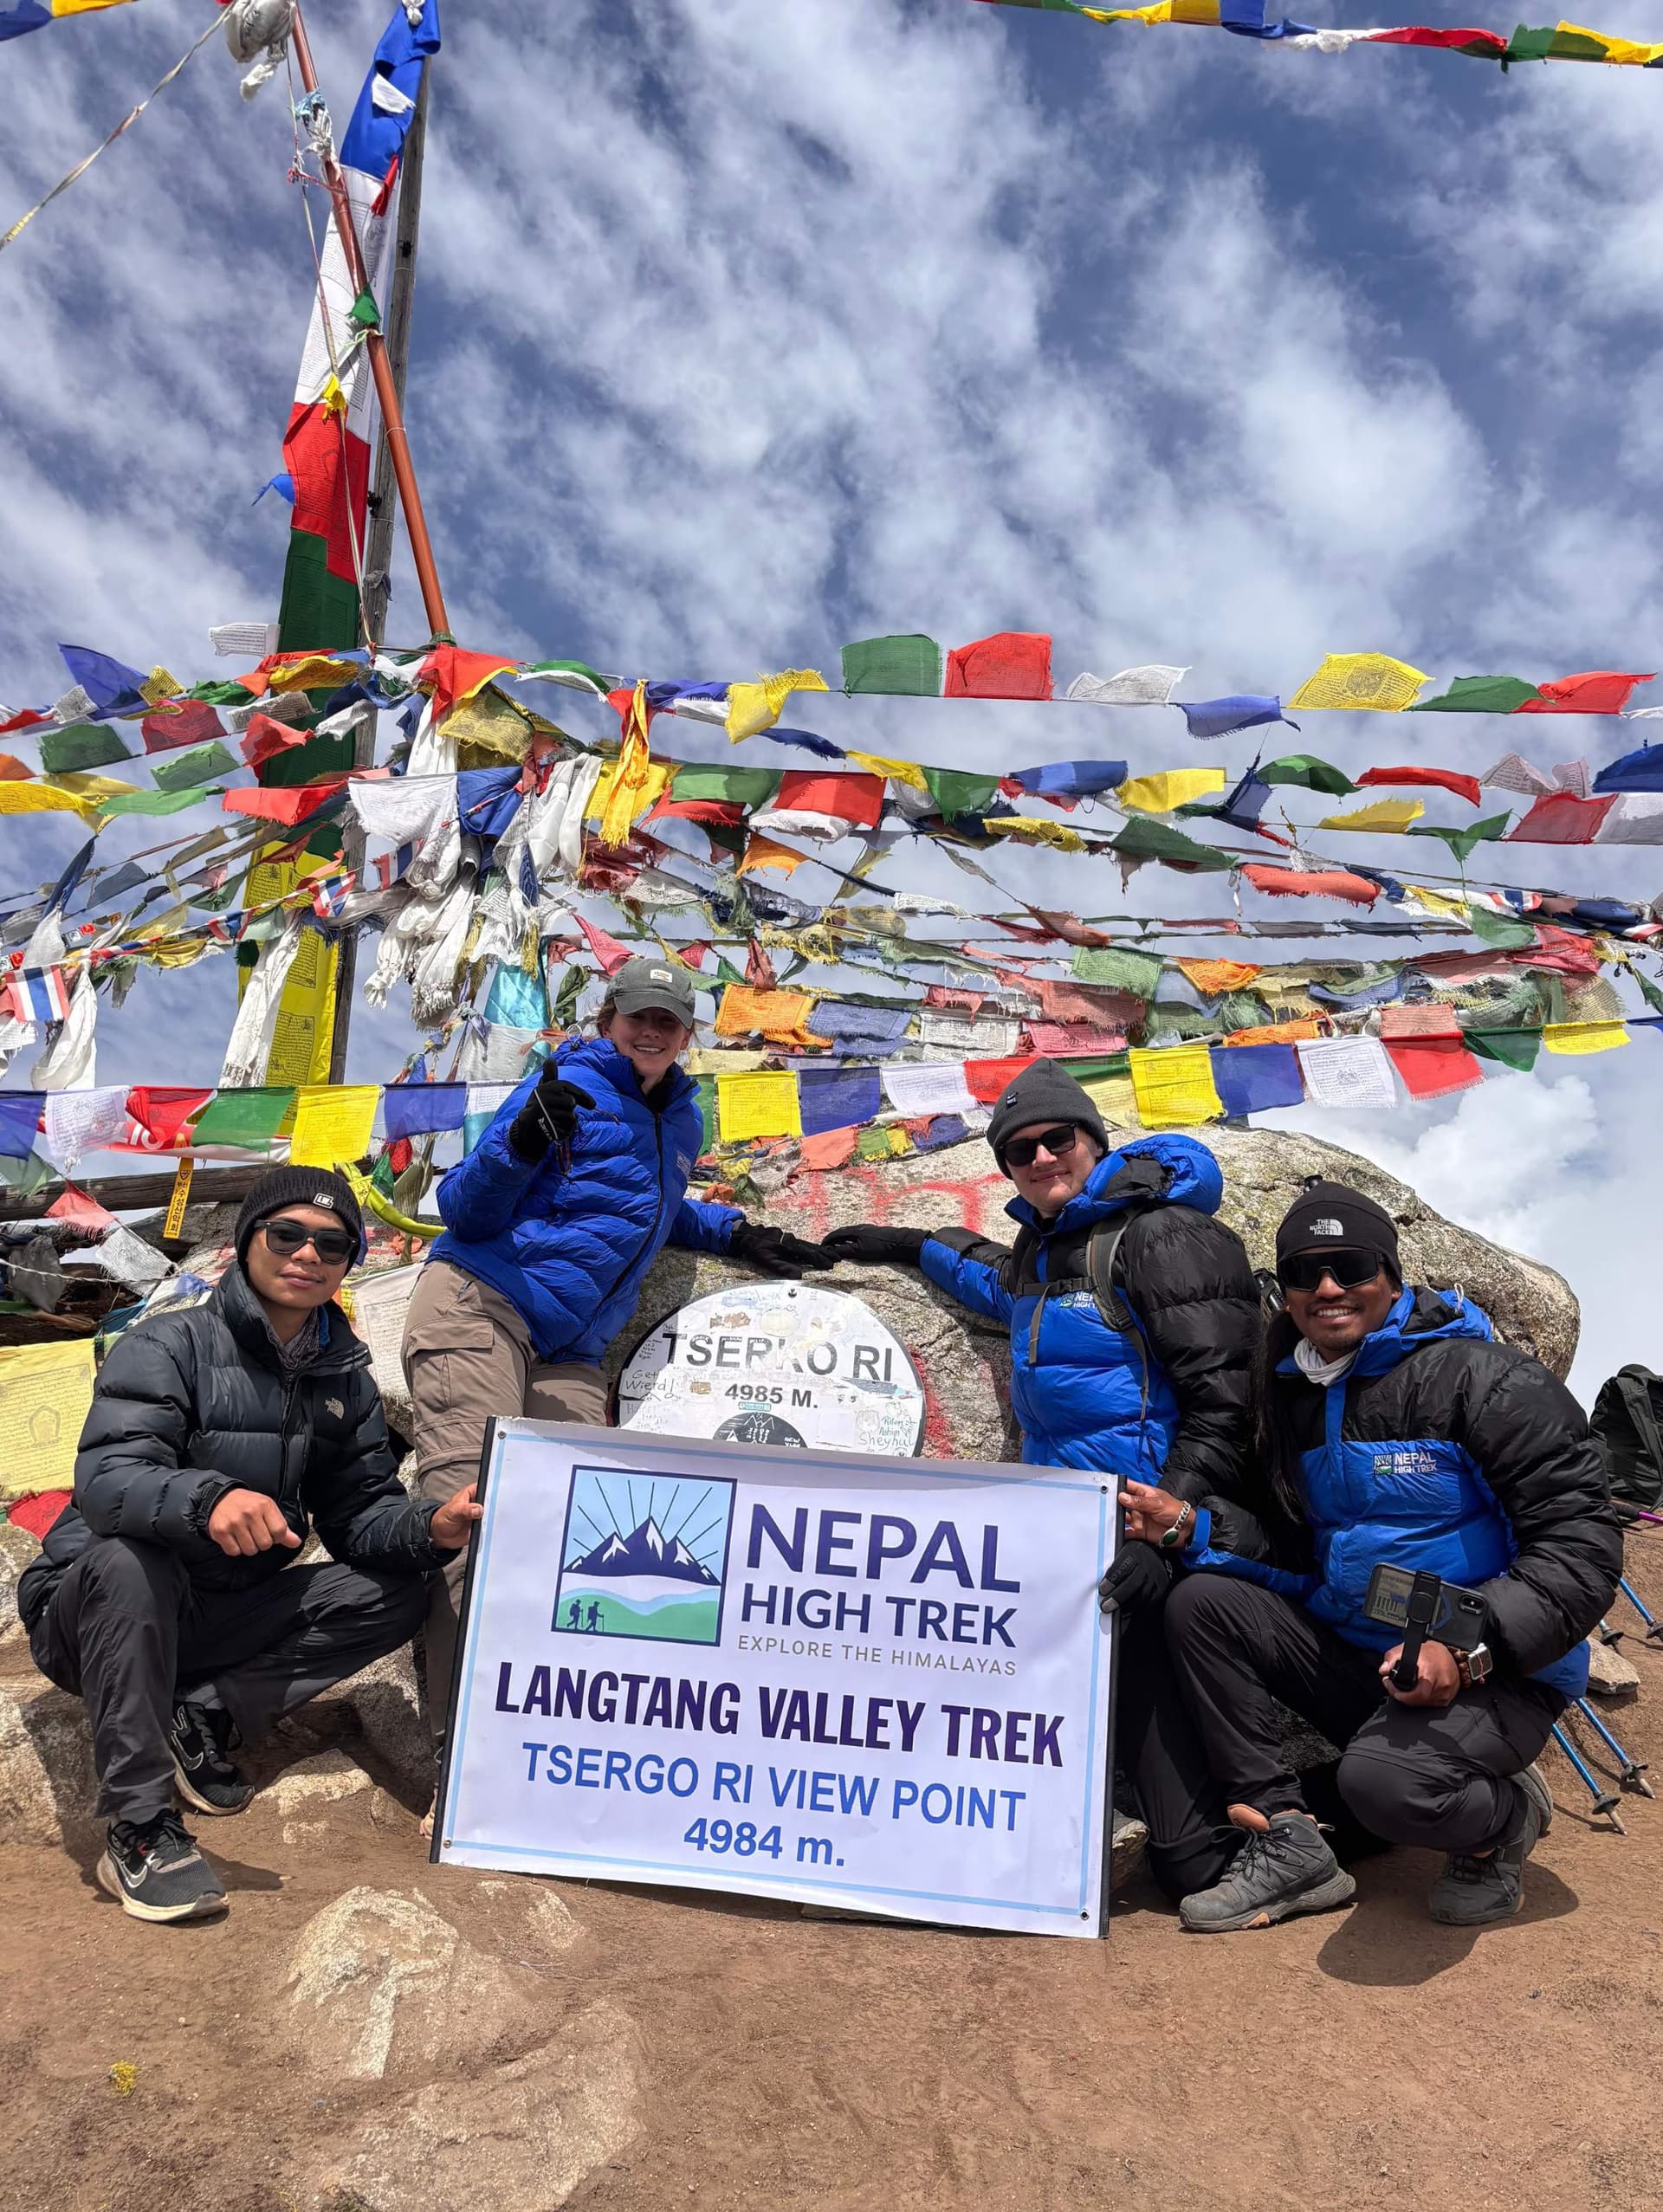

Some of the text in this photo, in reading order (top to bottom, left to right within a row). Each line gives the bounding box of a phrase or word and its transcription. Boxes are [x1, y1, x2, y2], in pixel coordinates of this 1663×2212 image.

[632, 1369, 659, 1379] Get
[852, 1344, 893, 1382] RI
[724, 1383, 819, 1409] 4985 M.
[1394, 1452, 1437, 1465] NEPAL
[1394, 1463, 1438, 1474] HIGH TREK
[746, 1503, 1021, 1594] NEPAL
[741, 1582, 1018, 1648] HIGH TREK
[738, 1634, 1016, 1676] EXPLORE THE HIMALAYAS
[495, 1661, 1065, 1768] LANGTANG VALLEY TREK
[522, 1742, 1026, 1832] TSERGO RI VIEW POINT
[683, 1817, 844, 1866] 4984 m.
